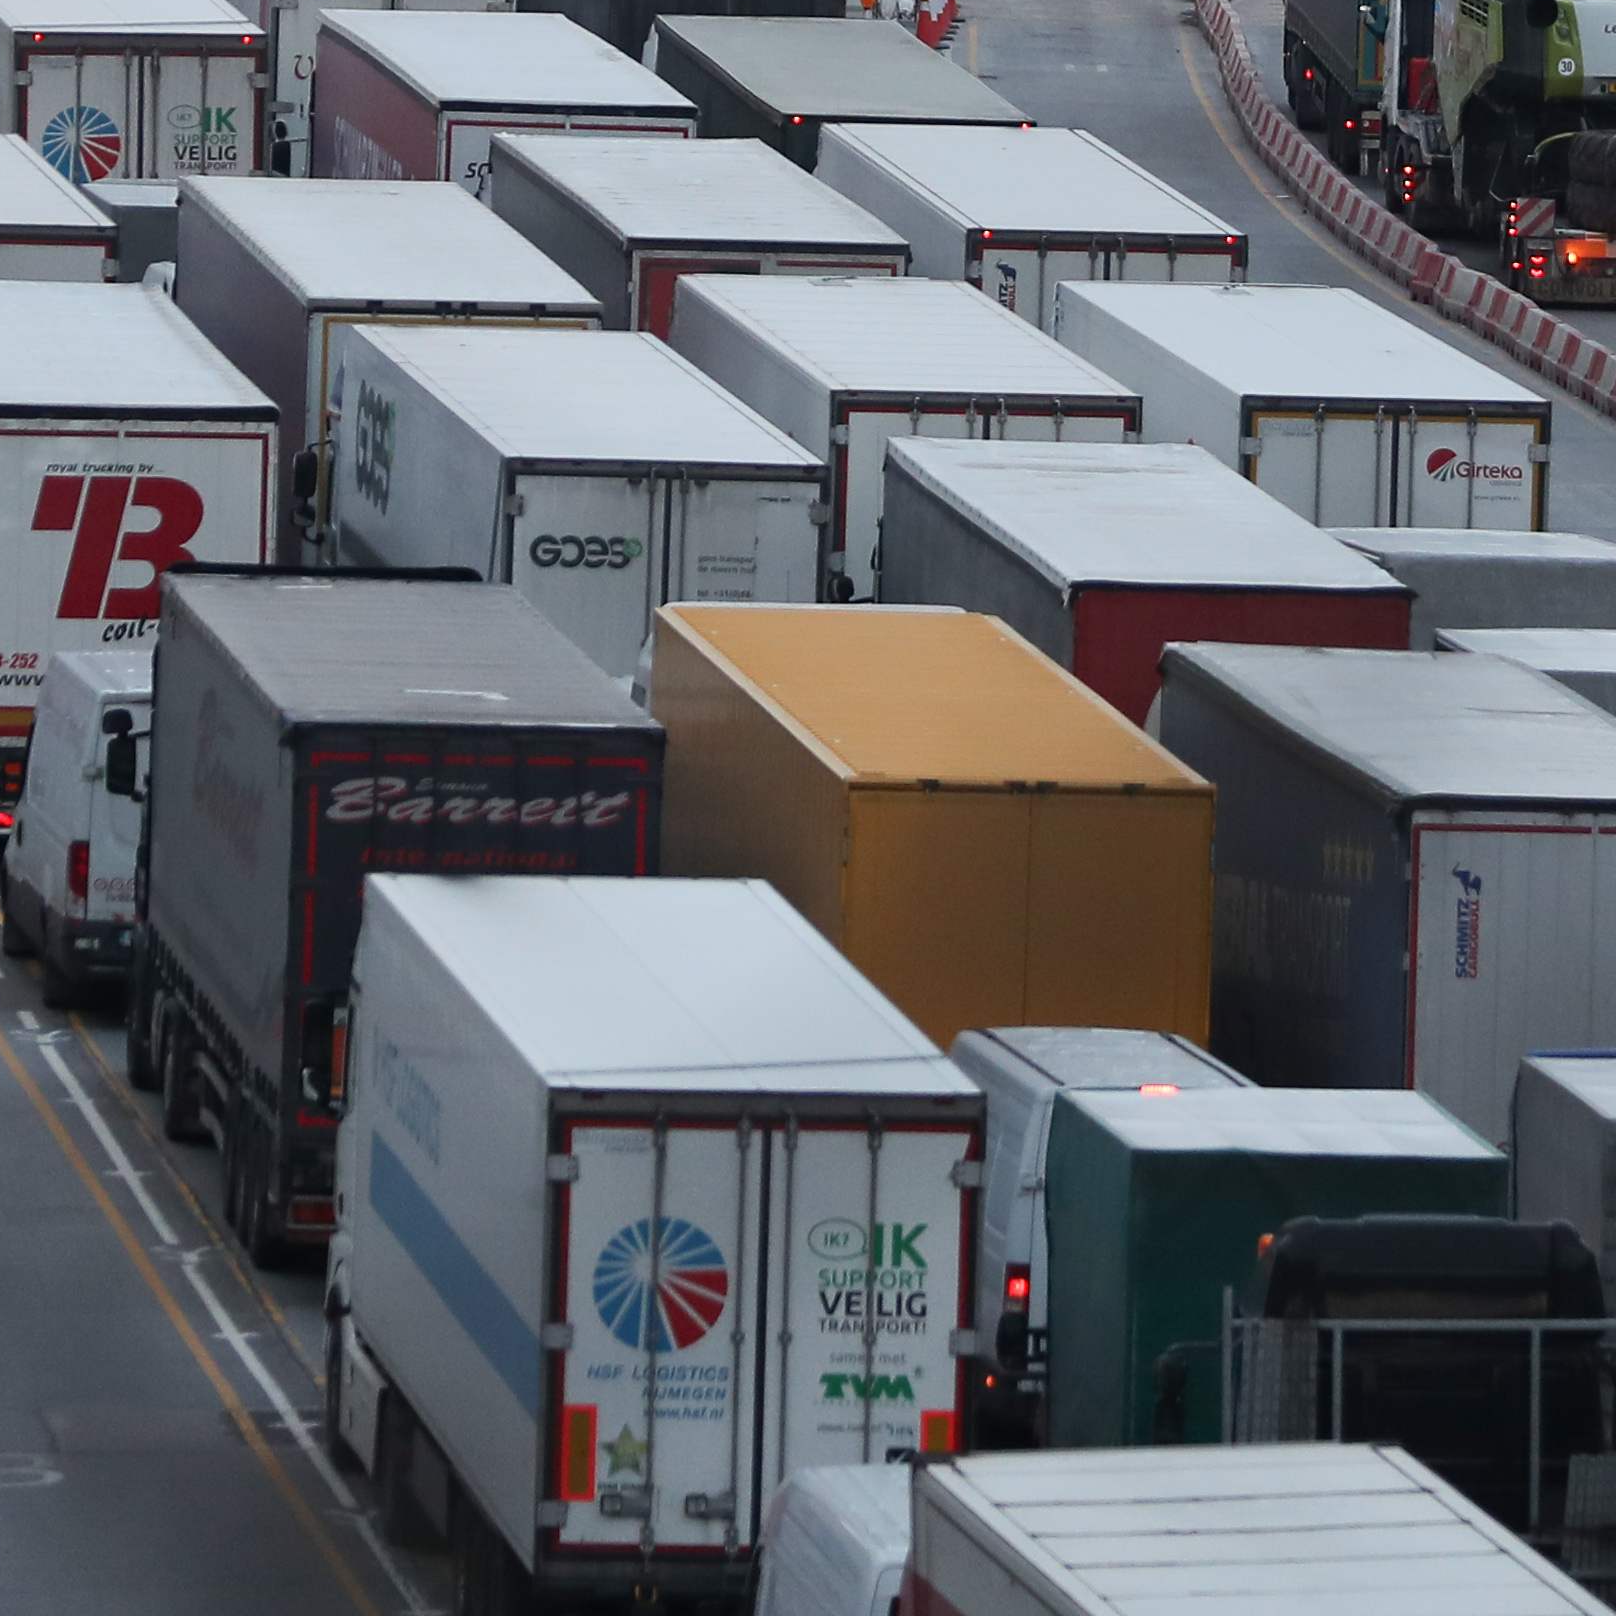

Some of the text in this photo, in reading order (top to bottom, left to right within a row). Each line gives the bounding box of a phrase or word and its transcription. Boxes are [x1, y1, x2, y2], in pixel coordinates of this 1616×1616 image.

[1560, 60, 1572, 73] 30
[203, 107, 237, 133] IK
[46, 463, 134, 474] royal trucking
[1456, 460, 1523, 479] Girteka
[325, 775, 631, 826] Barrett
[1455, 898, 1469, 978] SCHMITZ
[873, 1221, 929, 1269] IK
[818, 1290, 928, 1318] VELIG
[587, 1364, 624, 1382] HSF
[818, 1372, 916, 1402] TVM
